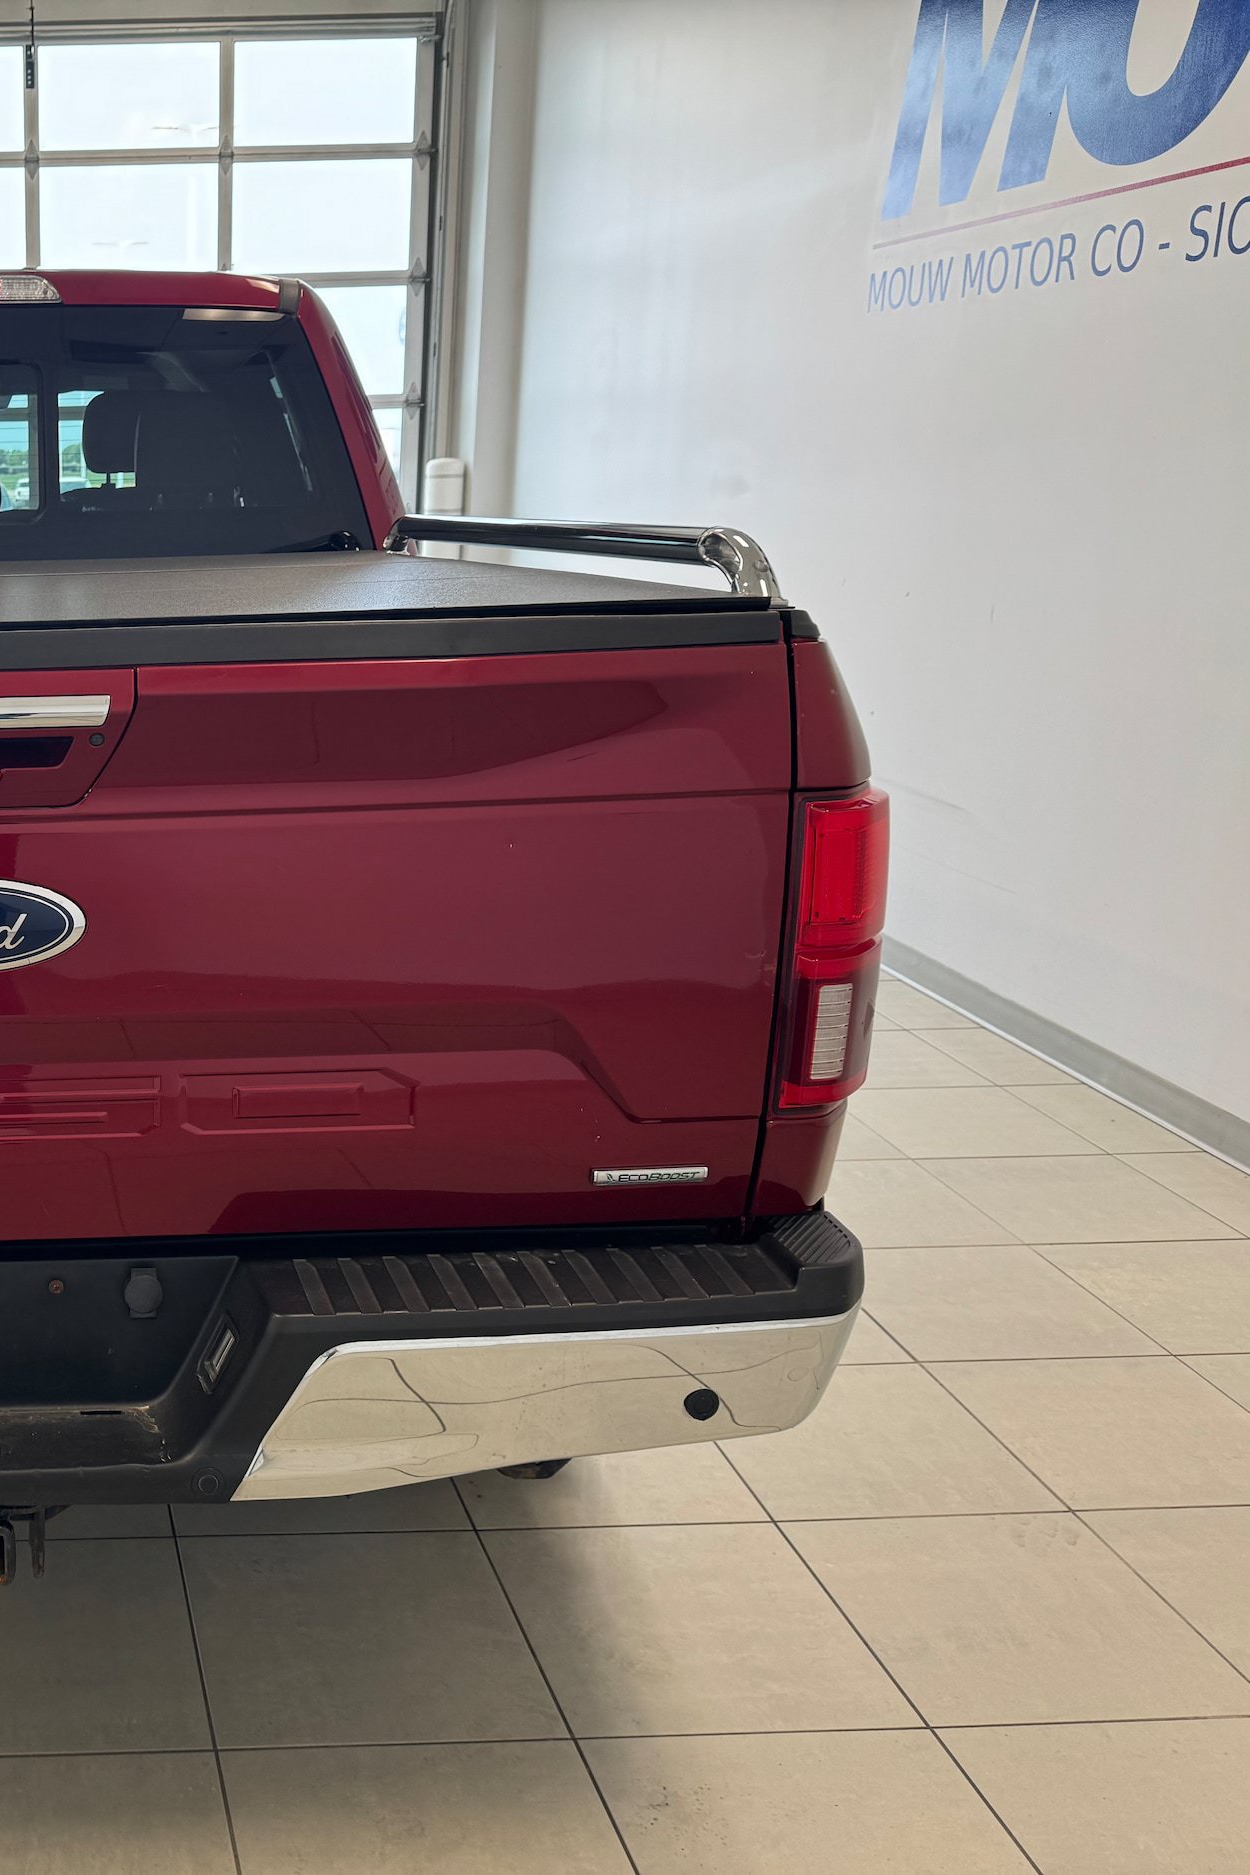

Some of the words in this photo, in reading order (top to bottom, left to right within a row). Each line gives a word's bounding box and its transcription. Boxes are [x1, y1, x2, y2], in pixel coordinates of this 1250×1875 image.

[866, 256, 955, 314] MOUW
[960, 232, 1077, 299] MOTOR
[1090, 218, 1145, 277] CO
